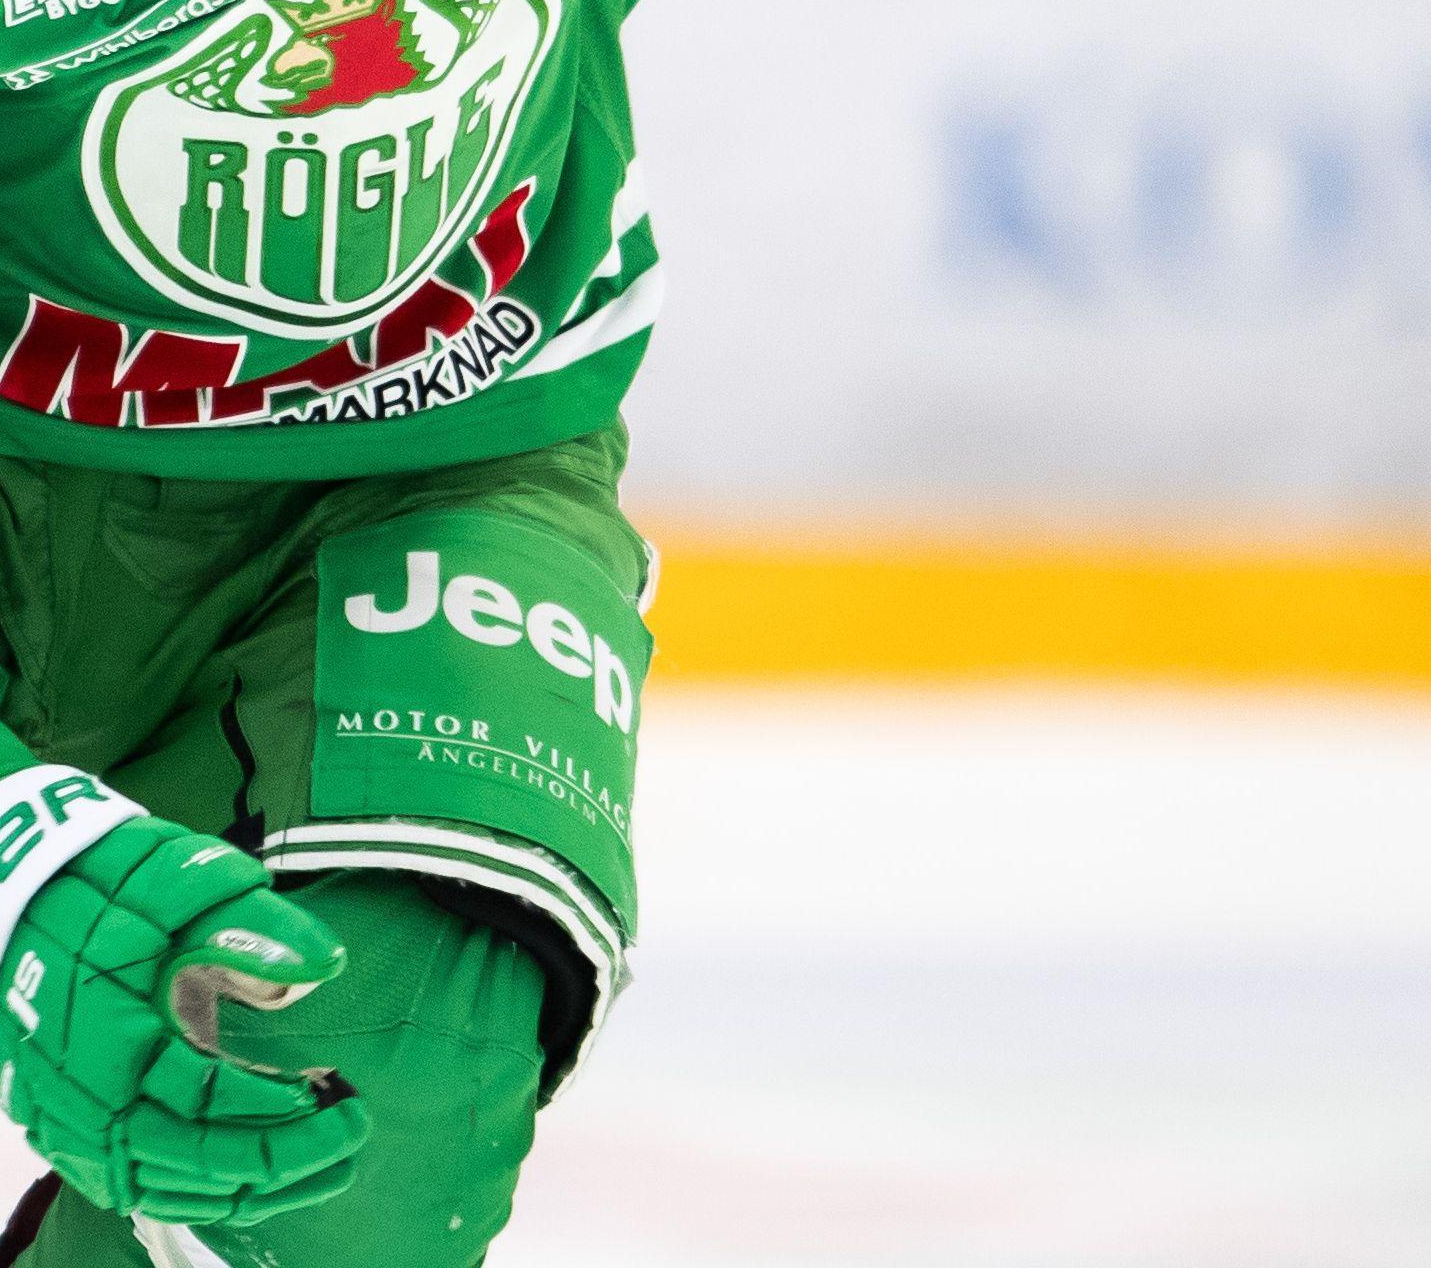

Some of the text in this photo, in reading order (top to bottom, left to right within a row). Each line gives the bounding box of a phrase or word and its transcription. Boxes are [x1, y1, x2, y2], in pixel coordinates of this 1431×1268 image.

[178, 57, 508, 305] RÖGLE
[345, 551, 633, 734] Jeep
[337, 710, 632, 830] MOTOR VILLAG
